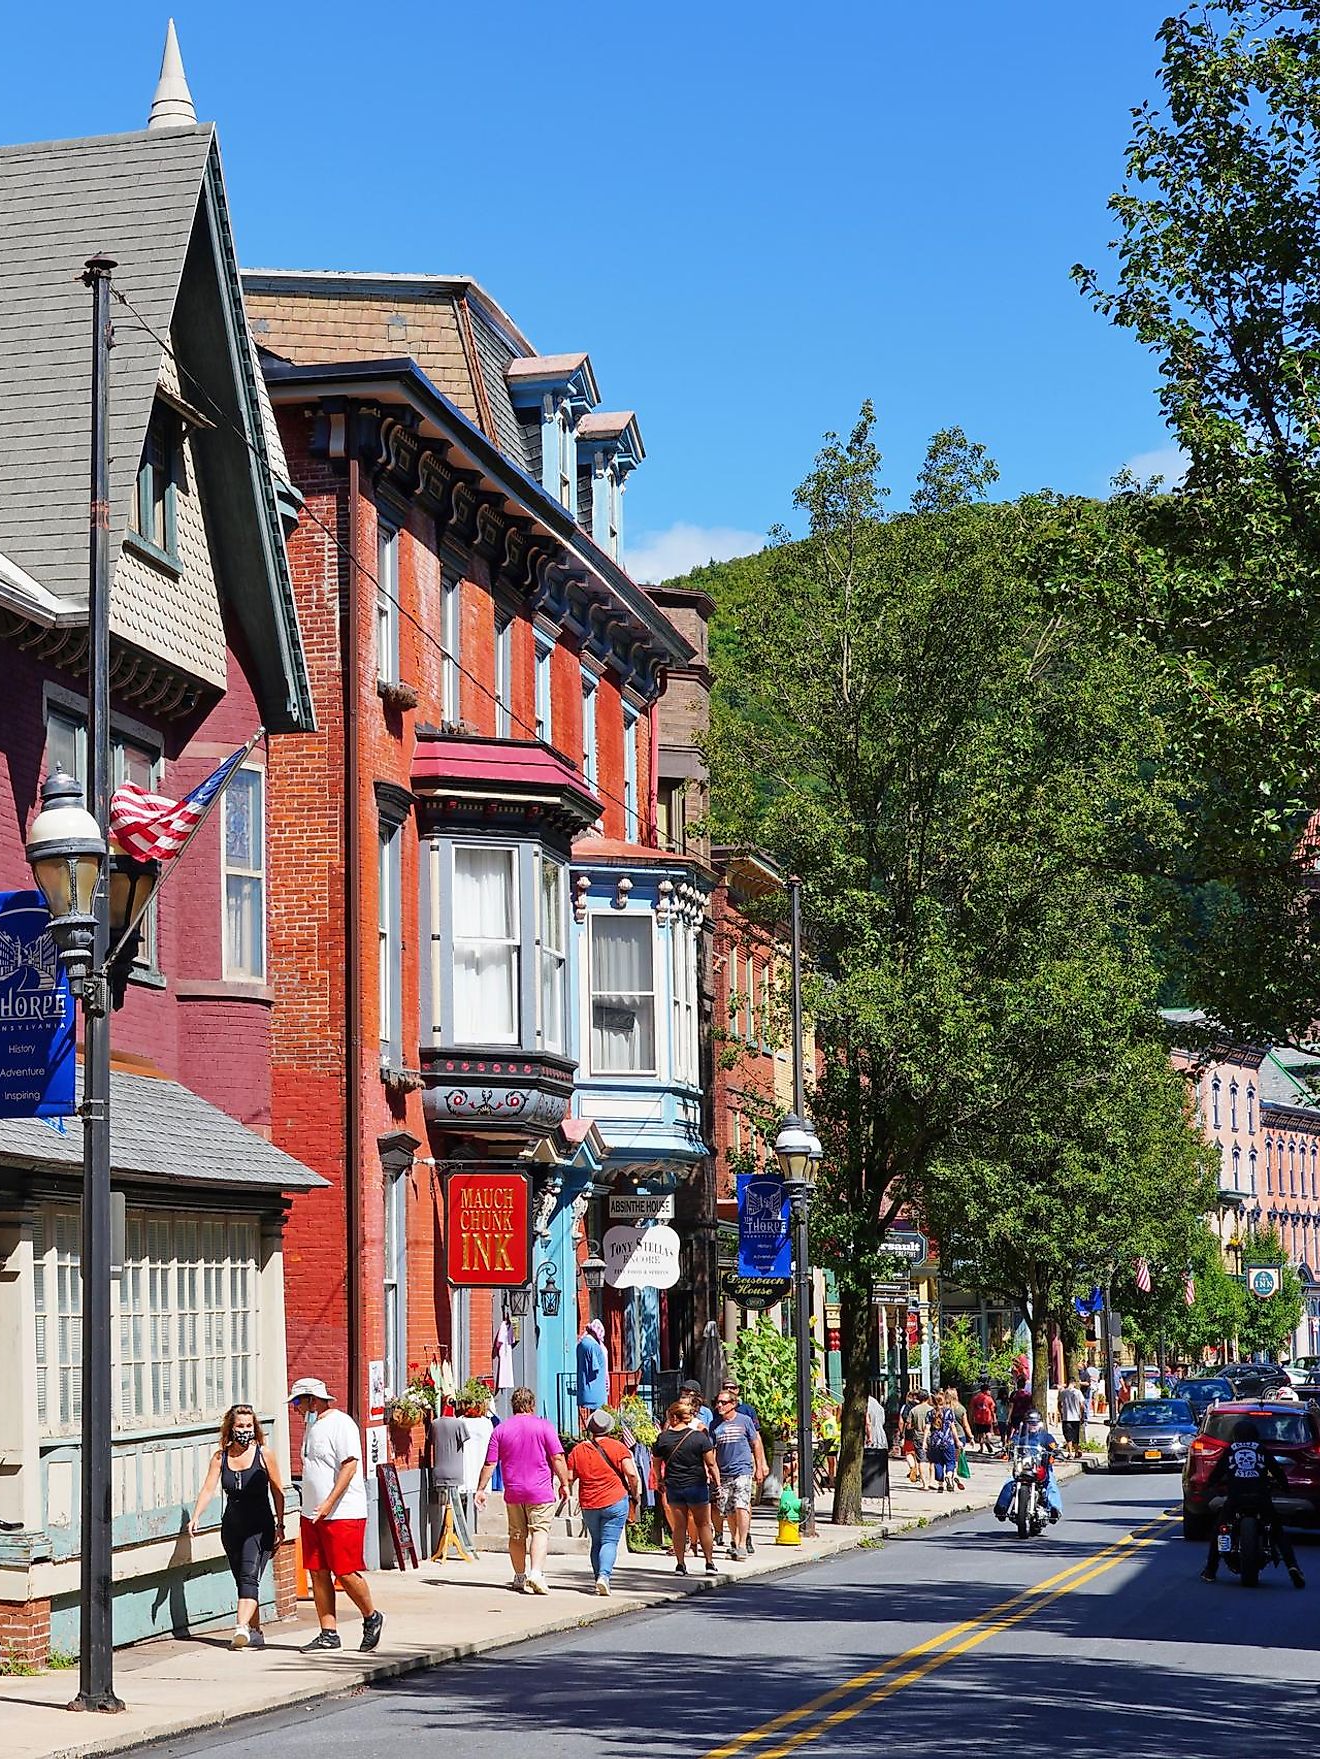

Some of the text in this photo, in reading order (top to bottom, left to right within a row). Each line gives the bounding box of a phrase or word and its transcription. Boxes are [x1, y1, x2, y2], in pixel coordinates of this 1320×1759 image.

[8, 1045, 36, 1054] History
[0, 1067, 46, 1078] Adventure
[4, 1091, 41, 1102] Inspiring
[460, 1188, 514, 1209] MAUCH
[611, 1200, 670, 1213] ABSINTHE HOUSE
[460, 1210, 514, 1230] CHUNK
[461, 1232, 515, 1271] INK
[610, 1242, 633, 1258] TONY
[734, 1284, 773, 1295] House
